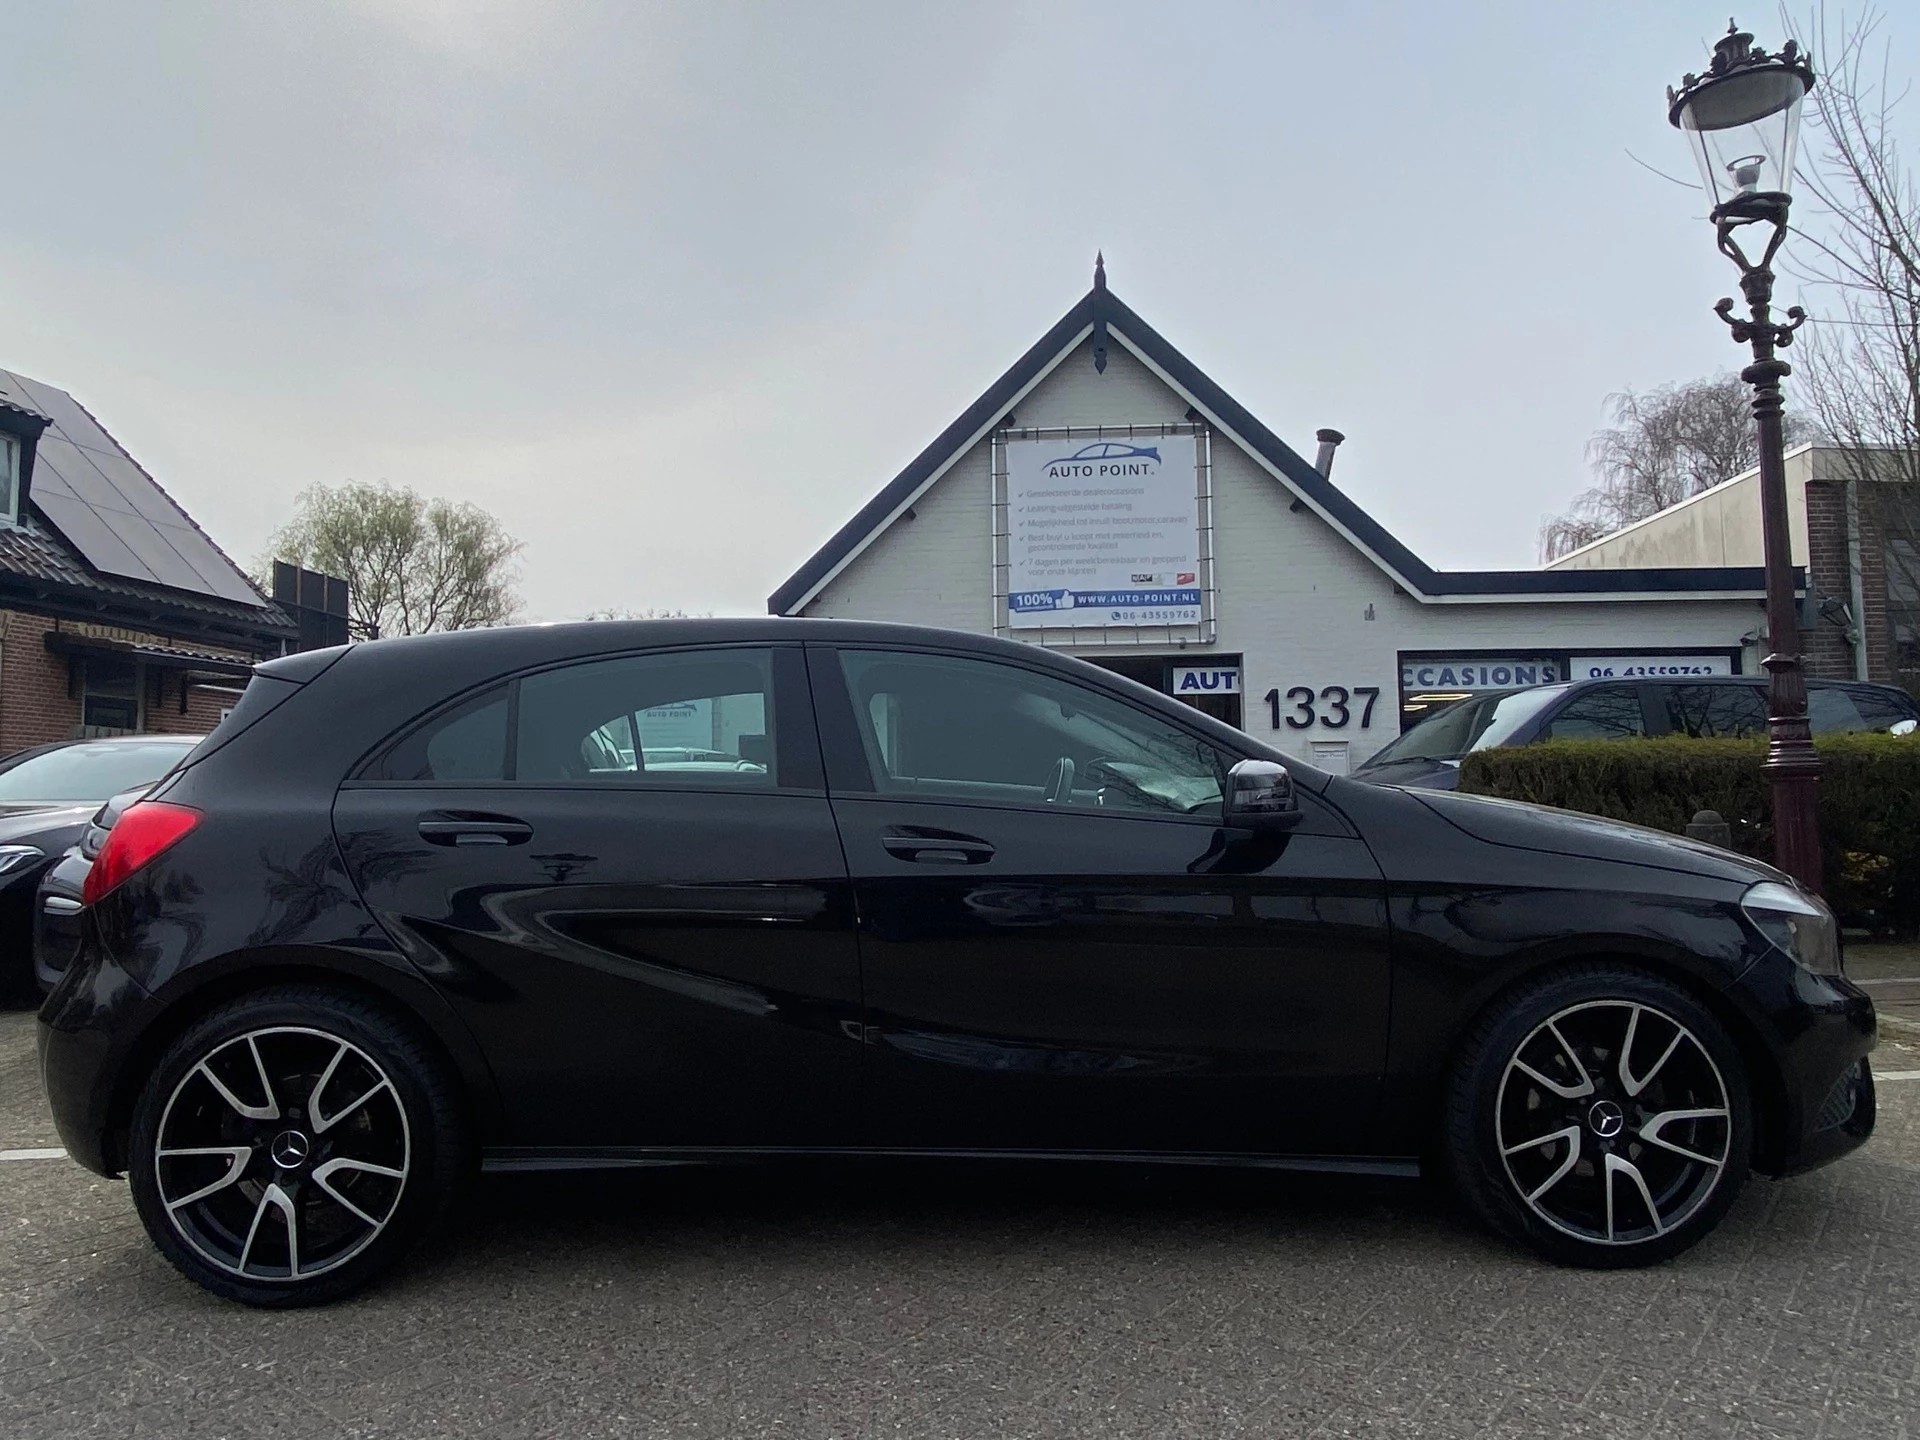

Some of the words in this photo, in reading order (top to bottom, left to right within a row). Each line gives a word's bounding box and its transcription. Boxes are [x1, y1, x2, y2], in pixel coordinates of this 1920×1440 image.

[1049, 465, 1093, 478] AUTO
[1034, 558, 1059, 567] dagen
[1060, 558, 1073, 566] per
[1028, 568, 1045, 576] voor
[1016, 592, 1053, 606] 100%
[1180, 671, 1239, 690] AUT
[1264, 686, 1380, 730] 1337
